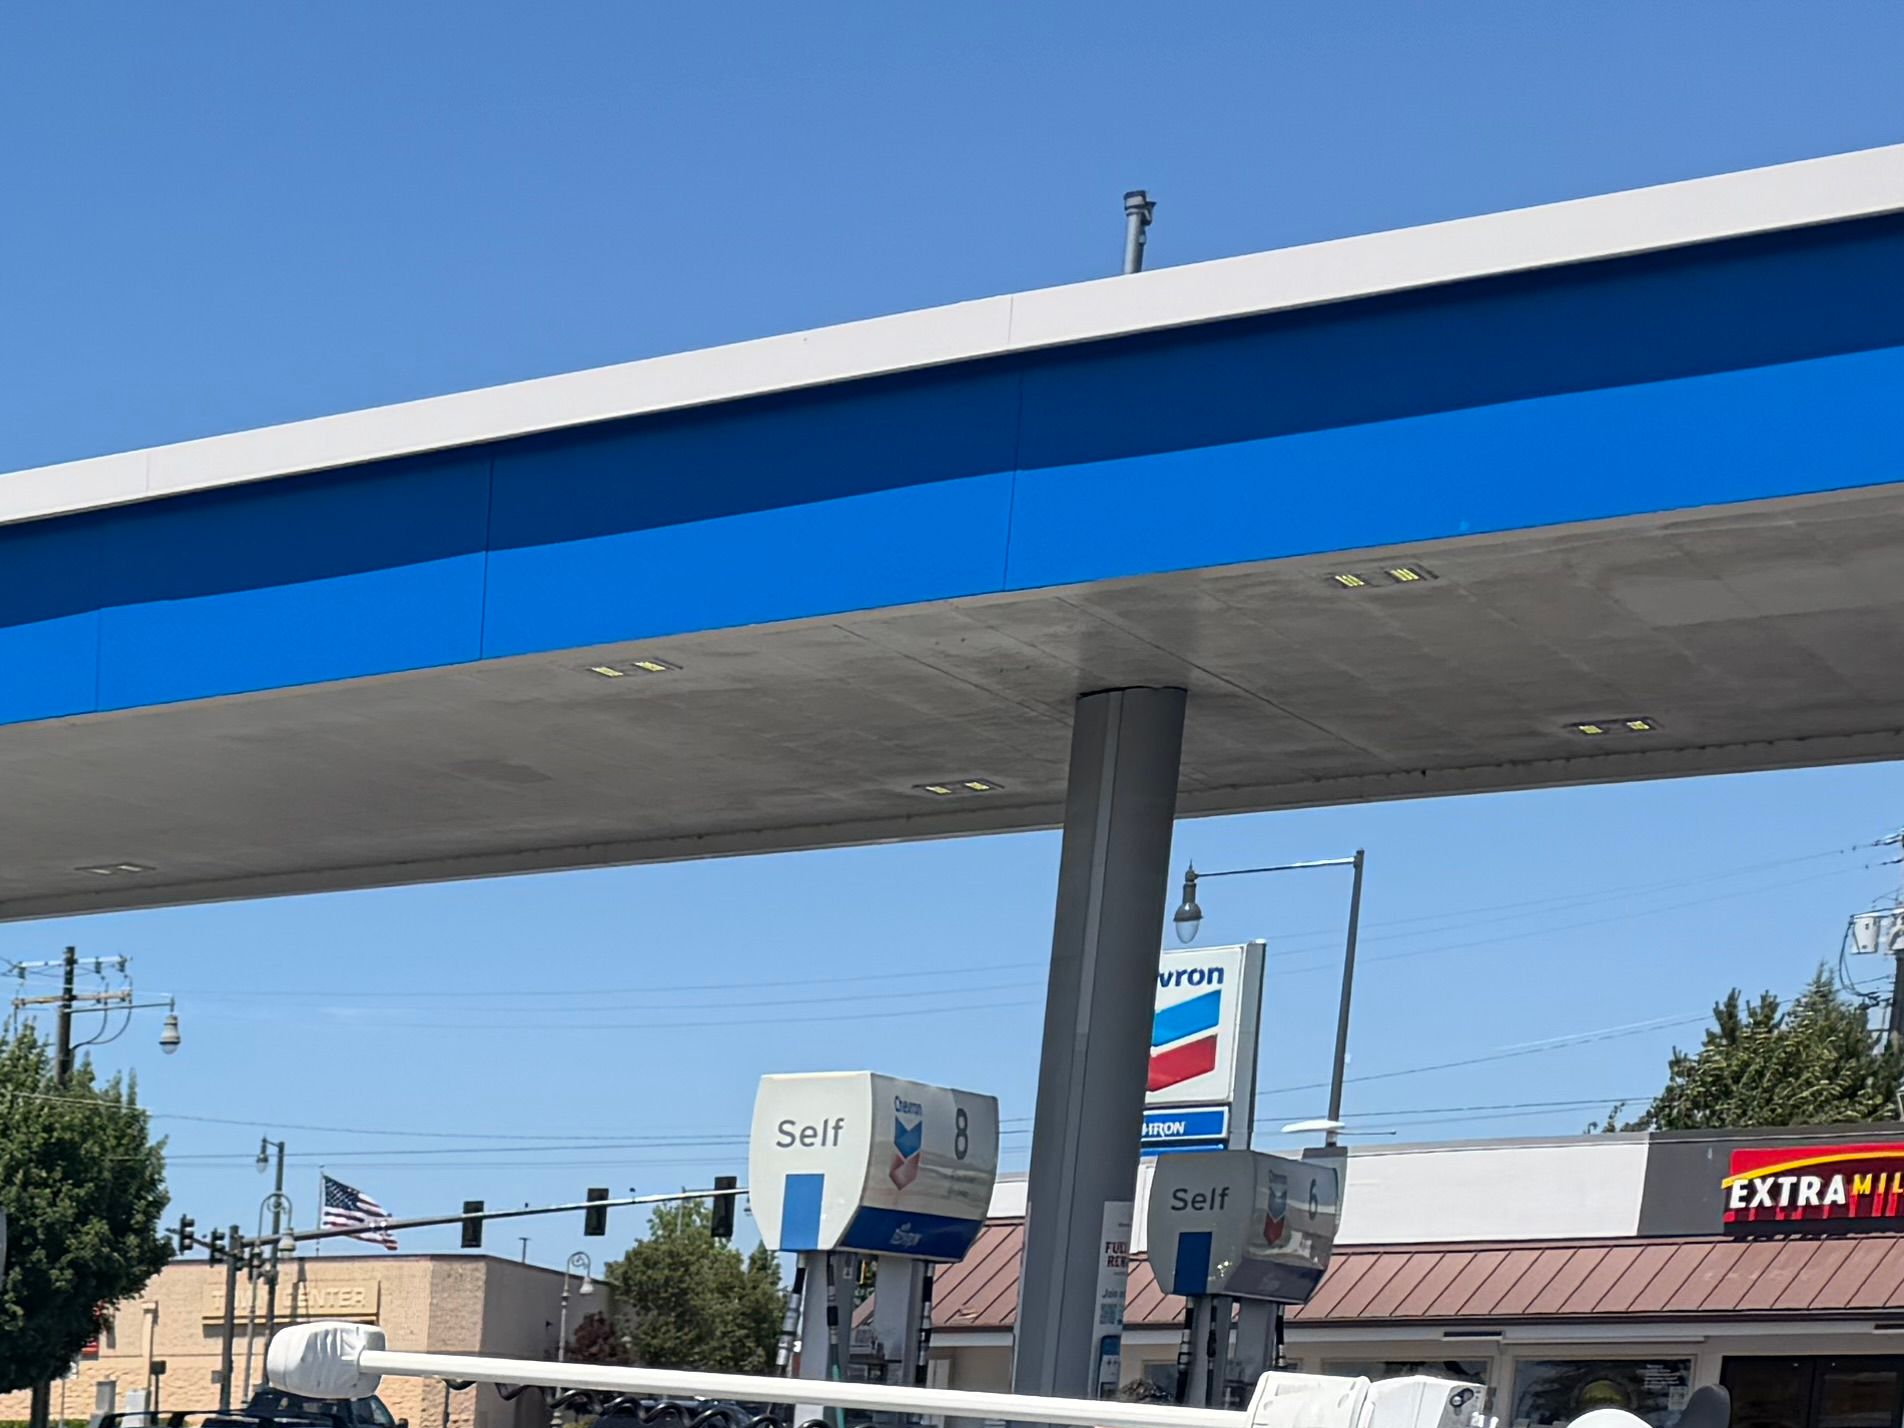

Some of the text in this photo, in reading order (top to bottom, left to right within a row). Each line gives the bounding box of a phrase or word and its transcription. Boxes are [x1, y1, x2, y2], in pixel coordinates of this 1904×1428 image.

[1158, 965, 1225, 988] vron
[775, 1117, 845, 1148] Self
[954, 1107, 969, 1161] 8
[1170, 1186, 1230, 1211] Self
[1308, 1178, 1318, 1221] 6
[1729, 1171, 1904, 1210] EXTRA MIL
